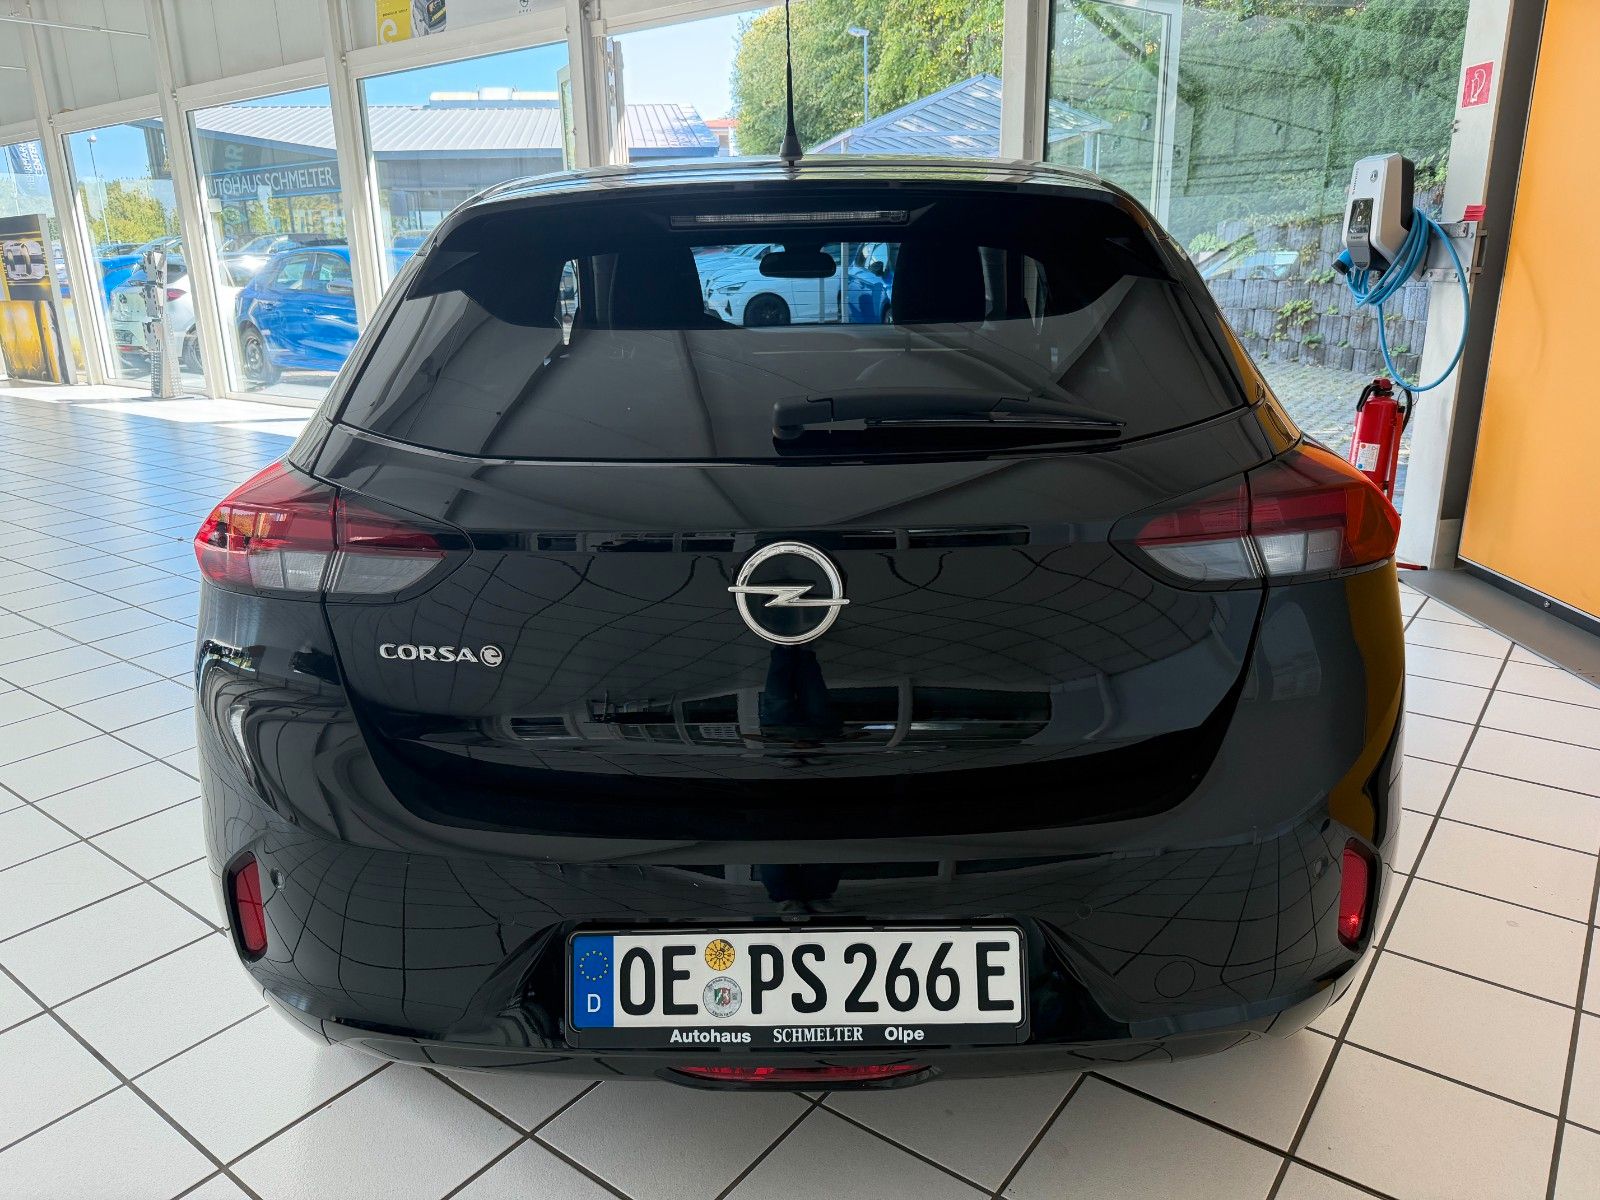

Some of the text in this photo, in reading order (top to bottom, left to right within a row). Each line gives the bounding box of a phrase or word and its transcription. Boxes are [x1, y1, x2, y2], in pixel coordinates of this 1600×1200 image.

[264, 166, 336, 191] SCHMELTER
[379, 643, 479, 663] CORSA
[619, 945, 699, 1016] OE
[587, 993, 601, 1013] D
[669, 1026, 925, 1044] Autohaus SCHMELTER Olpe
